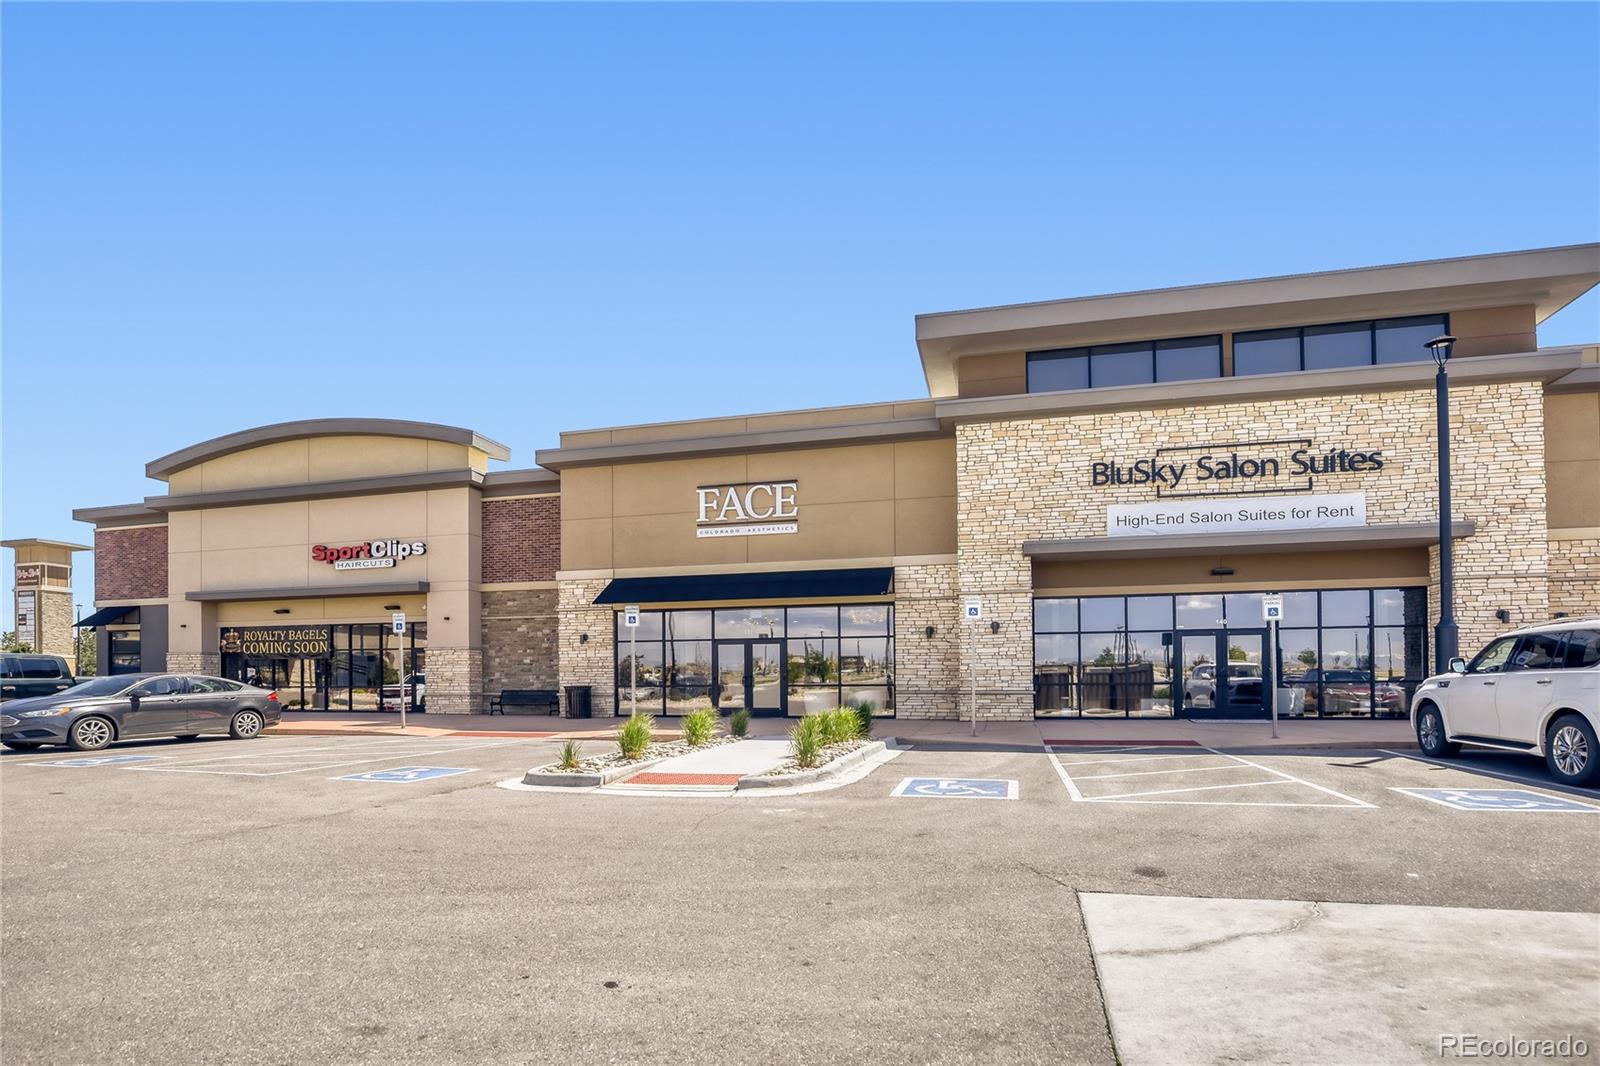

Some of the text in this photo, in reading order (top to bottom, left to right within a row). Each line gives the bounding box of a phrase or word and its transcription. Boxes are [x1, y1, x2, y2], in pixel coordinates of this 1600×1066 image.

[1092, 447, 1384, 489] BluSky Salon Suites
[696, 483, 798, 522] FACE
[1116, 504, 1355, 529] High-End Salon Suites for Rent
[336, 559, 392, 569] HAIRCUTS
[243, 628, 328, 641] ROYALTY BAGELS
[242, 641, 329, 655] COMING SOON
